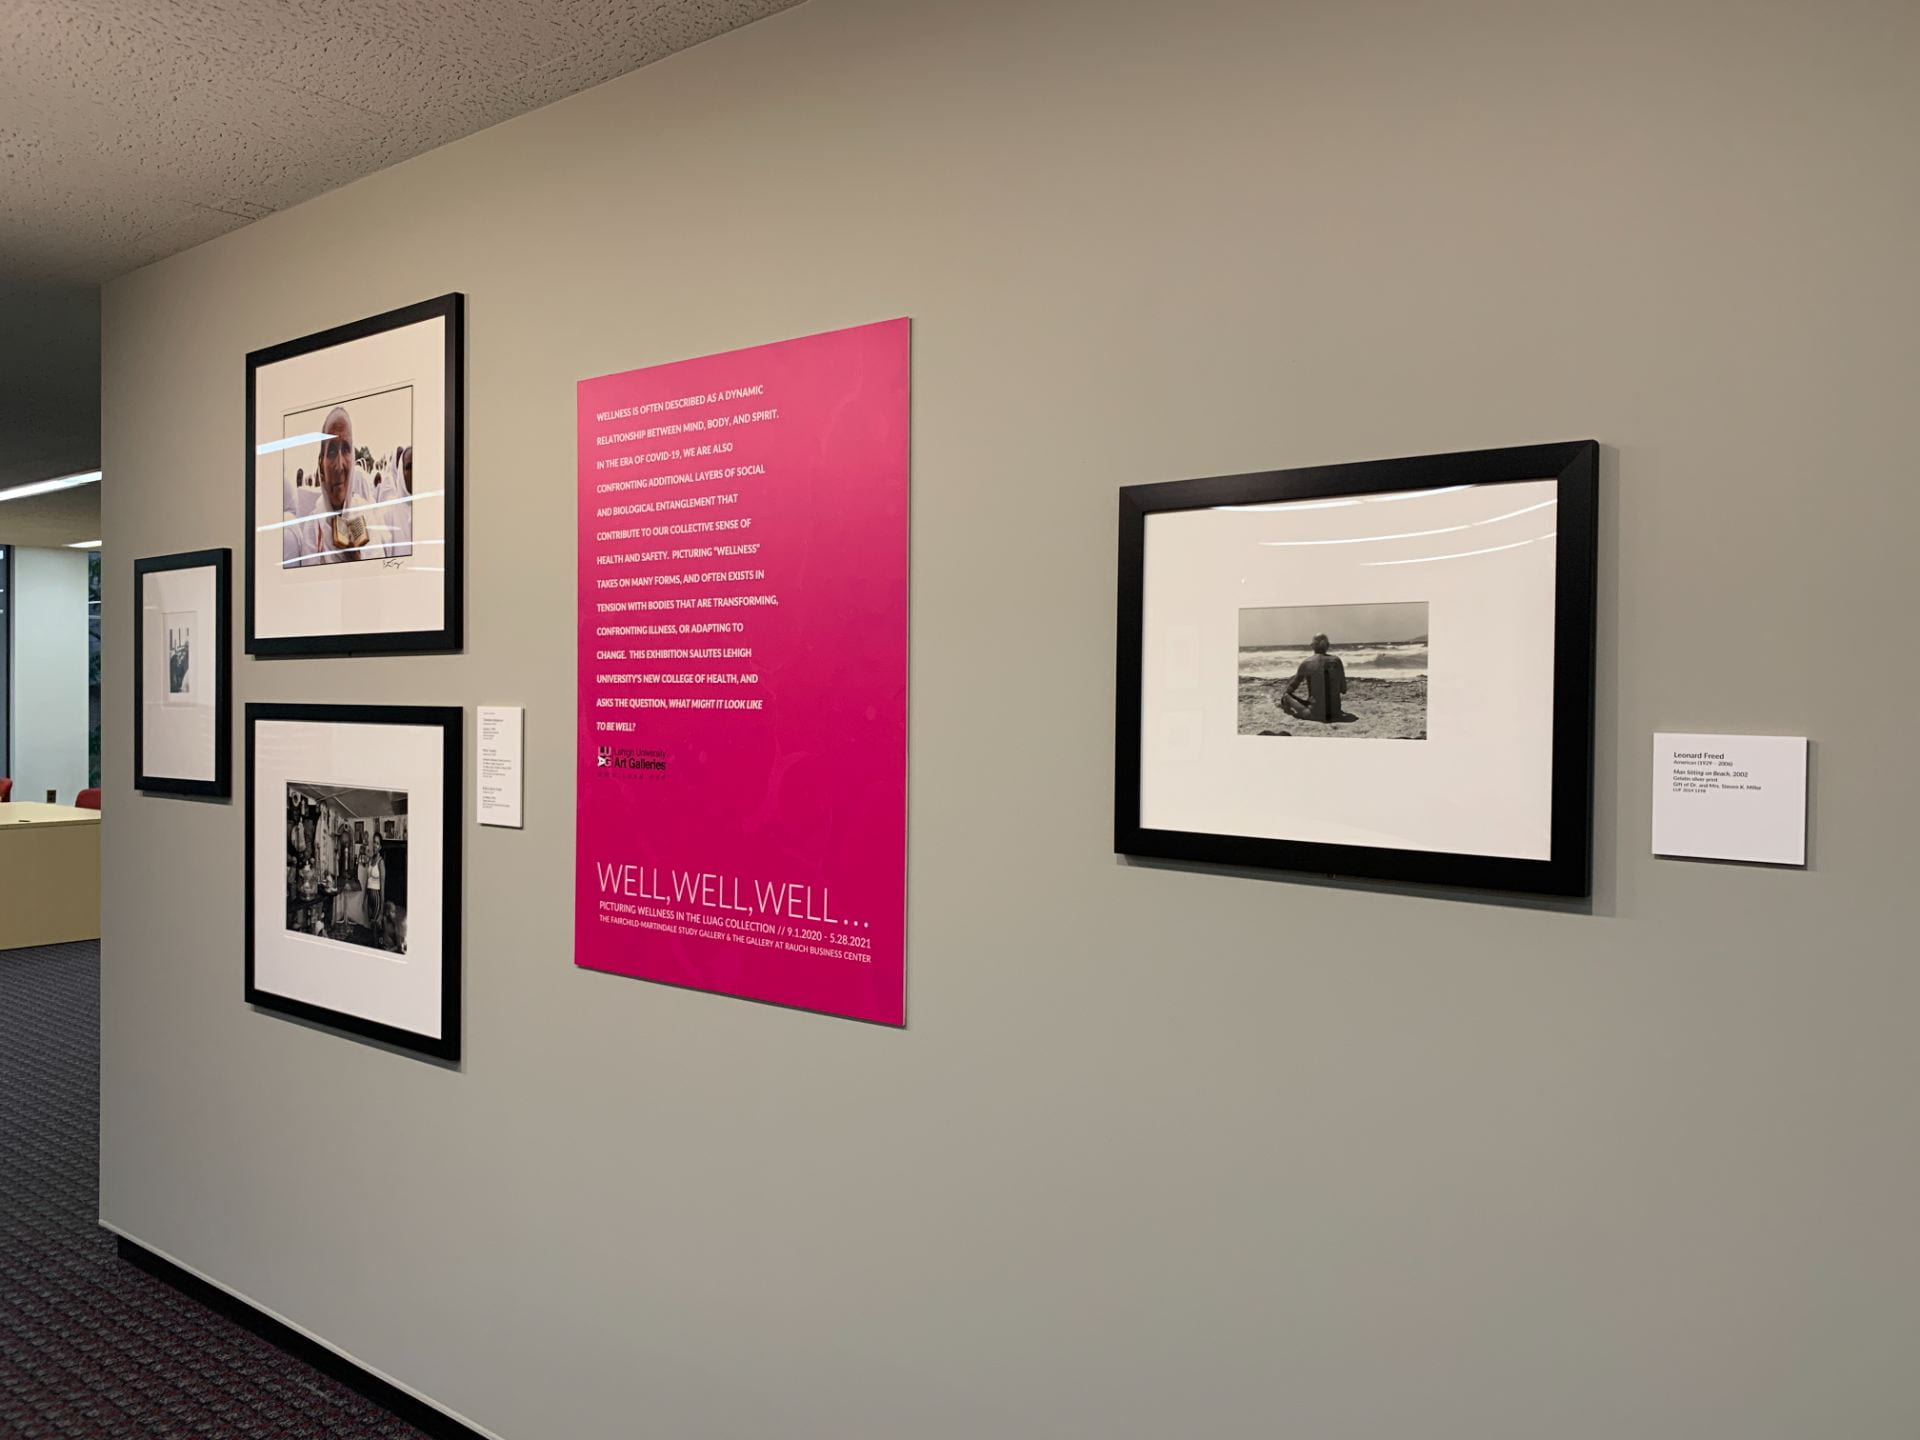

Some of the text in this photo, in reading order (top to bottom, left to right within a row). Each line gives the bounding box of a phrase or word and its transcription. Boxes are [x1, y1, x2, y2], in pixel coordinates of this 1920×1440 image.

[597, 385, 763, 422] WELLNESS IS OFTEN DESCRIBED AS A DYNAMIC
[597, 409, 779, 445] RELATIONSHIP BETWEEN MIND, BODY, AND SPIRIT.
[597, 443, 733, 469] IN THE ERA OF COVID-19, WE ARE ALSO
[597, 465, 765, 493] CONFRONTING ADDITIONAL LAYERS OF SOCIAL
[597, 494, 738, 517] AND BIOLOGICAL ENTANGLEMENT THAT
[597, 518, 751, 541] CONTRIBUTE TO OUR COLLECTIVE SENSE OF
[597, 555, 623, 565] HEALTH
[625, 554, 639, 563] AND
[642, 551, 669, 562] SAFETY.
[672, 548, 712, 559] PICTURING
[597, 570, 764, 589] TAKES ON MANY FORMS, AND OFTEN EXISTS IN
[597, 595, 778, 612] TENSION WITH BODIES THAT ARE TRANSFORMING,
[597, 623, 743, 636] CONFRONTING ILLNESS, OR ADAPTING TO
[597, 648, 751, 659] CHANGE. THIS EXHIBITION SALUTES LEHIGH
[597, 674, 758, 684] UNIVERSITY'S NEW COLLEGE OF HEALTH, AND
[597, 698, 762, 709] ASKS THE QUESTION, WHAT MIGHT IT LOOK LIKE
[597, 722, 636, 732] TO BE WELL?
[615, 758, 665, 770] Art Galleries
[600, 901, 636, 914] PICTURING
[638, 906, 674, 920] WELLNESS
[676, 912, 684, 921] IN
[686, 912, 700, 924] THE
[703, 914, 723, 927] LUAG
[725, 918, 775, 934] COLLECTION
[788, 927, 822, 941] 9.1.2020
[830, 933, 871, 949] 5.28.2021
[600, 915, 610, 923] THE
[611, 917, 677, 934] FAIRCHILD-MARTINDALE
[679, 926, 697, 936] STUDY
[699, 929, 725, 941] GALLERY
[733, 934, 744, 943] THE
[746, 936, 773, 948] GALLERY
[775, 940, 783, 949] AT
[785, 941, 808, 953] RAUCH
[810, 946, 842, 959] BUSINESS
[844, 951, 871, 963] CENTER
